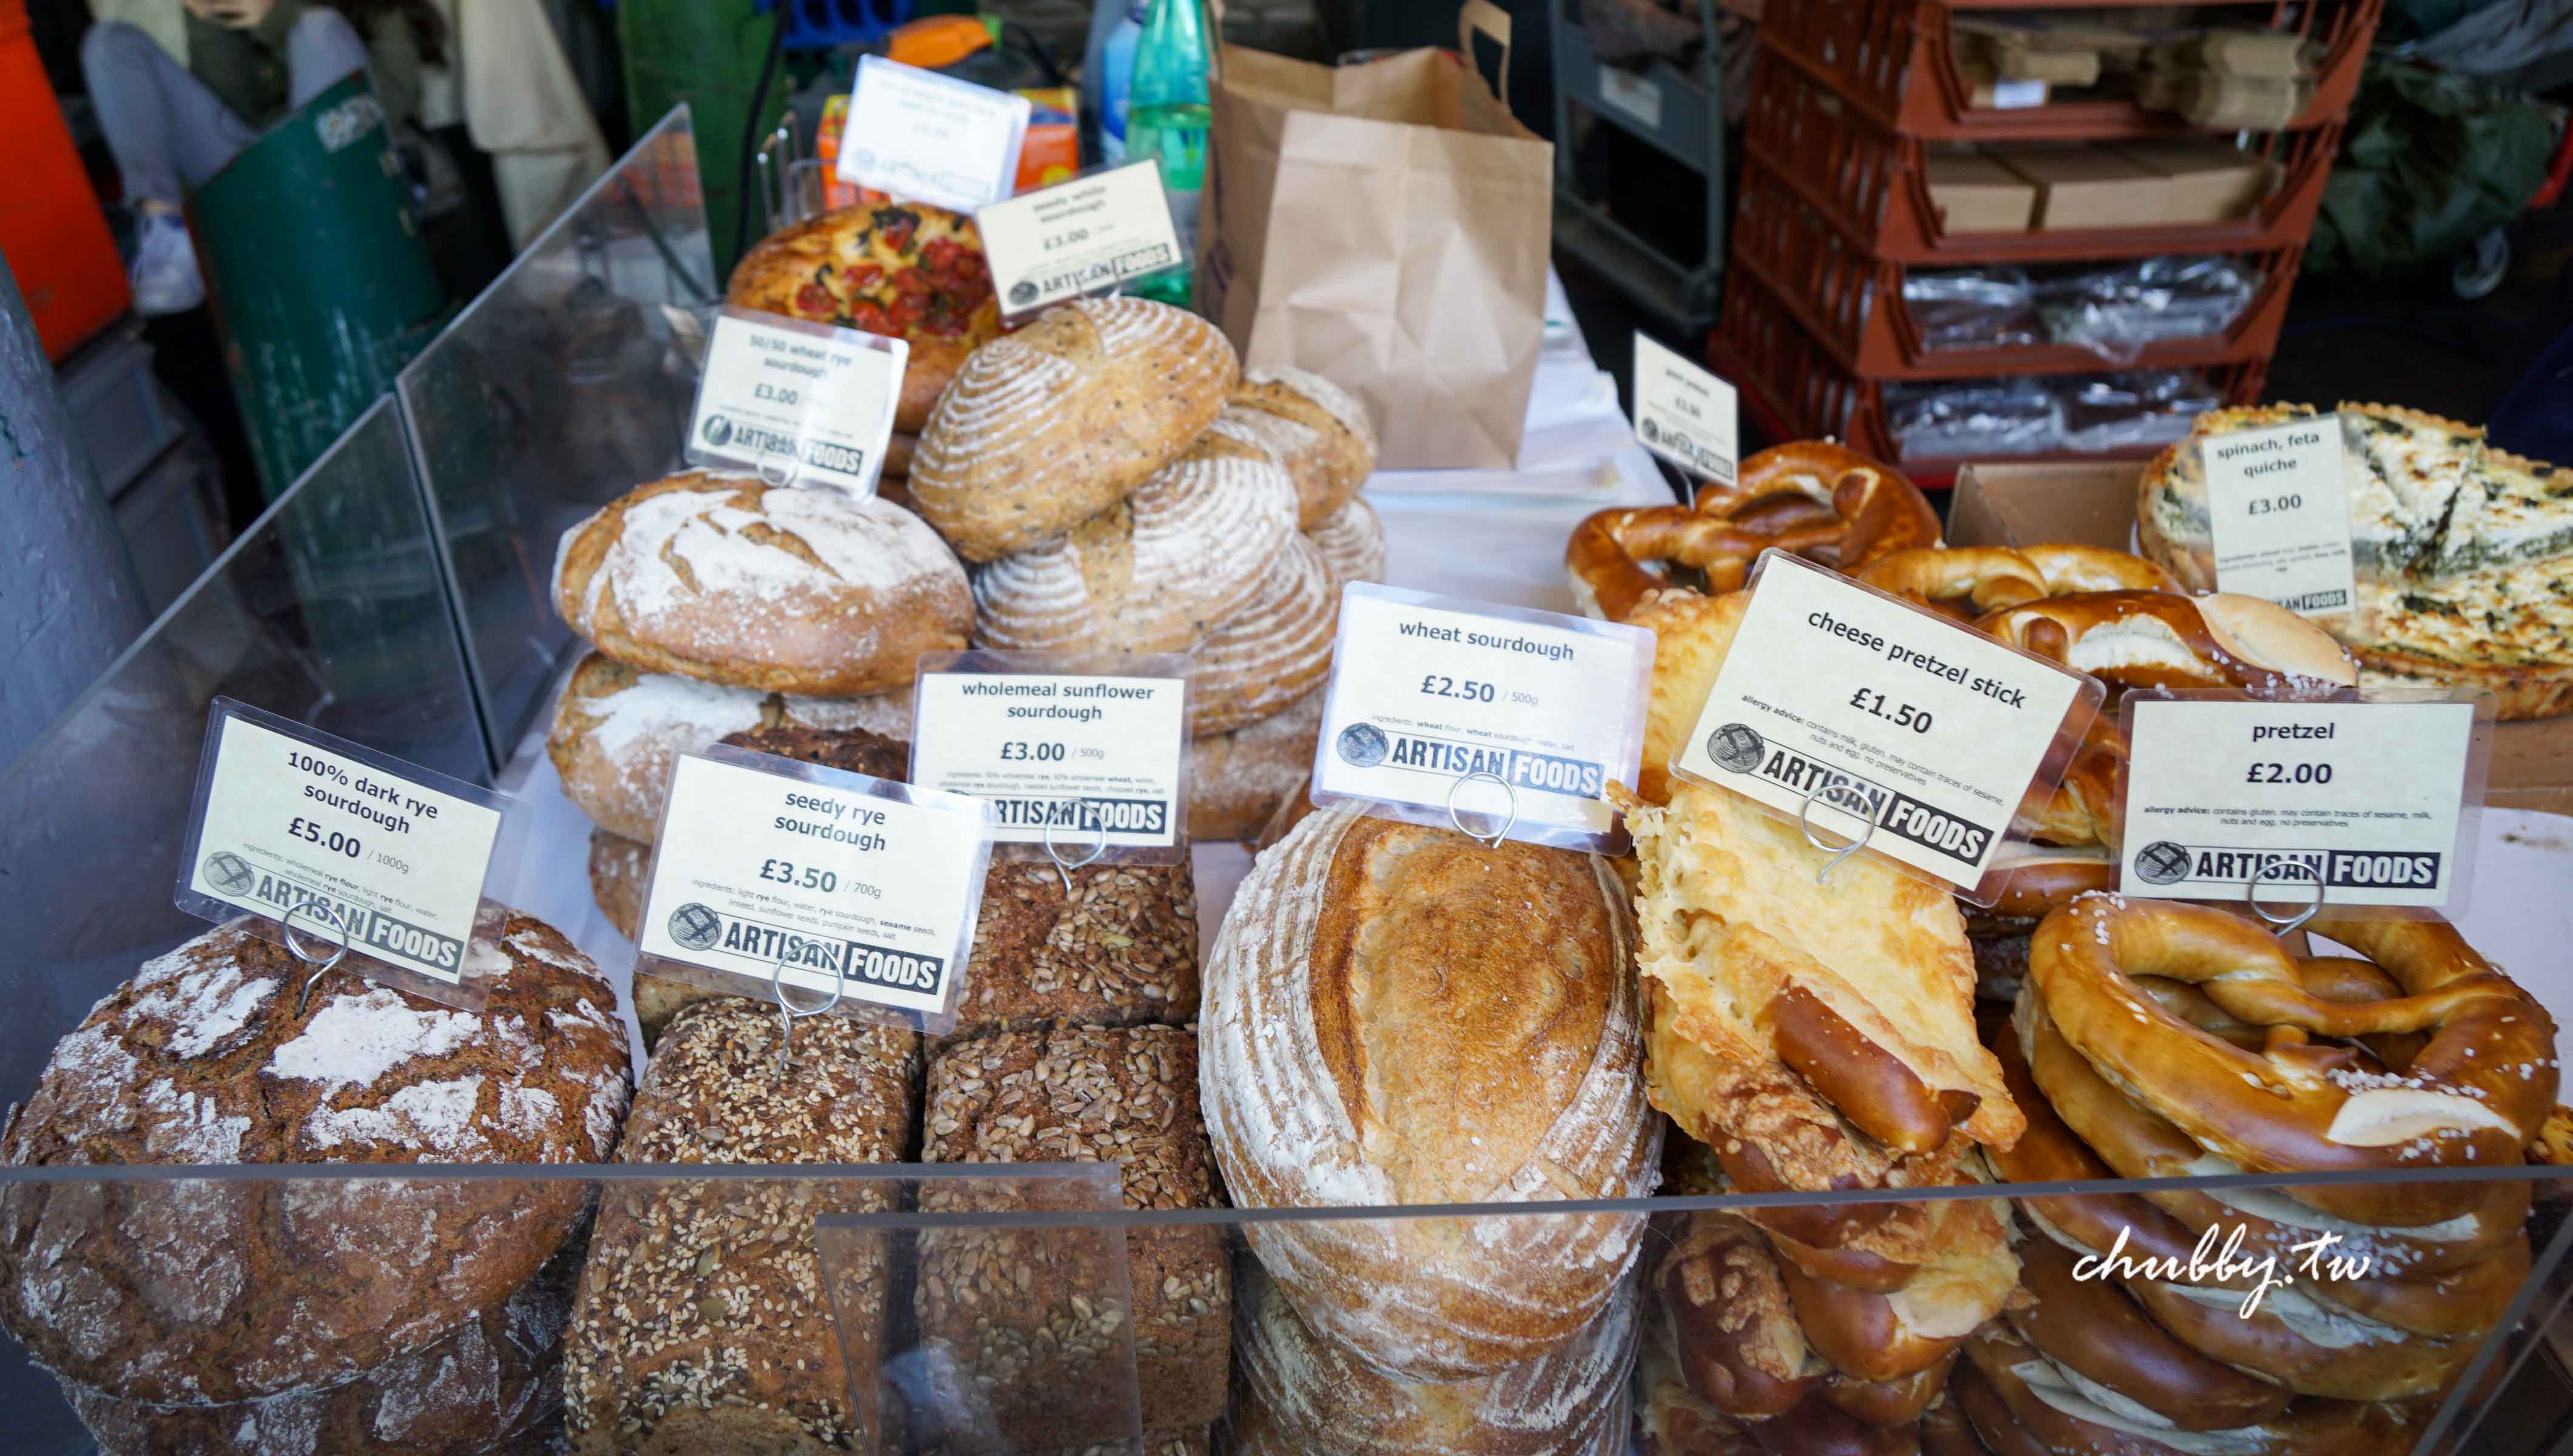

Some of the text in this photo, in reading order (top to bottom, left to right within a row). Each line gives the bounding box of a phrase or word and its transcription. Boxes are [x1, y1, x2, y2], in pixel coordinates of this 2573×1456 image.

[754, 383, 797, 405] £3.00
[2217, 433, 2320, 460] spinach, feta
[2244, 459, 2297, 478] quiche
[2248, 494, 2302, 515] £3.00
[1399, 622, 1575, 660] wheat sourdough
[1808, 609, 2026, 709] cheese pretzel stick
[962, 682, 1155, 699] wholemeal sunflower
[1421, 675, 1495, 703] £2.50
[1512, 692, 1538, 706] 500g
[1007, 704, 1103, 722] sourdough
[1850, 686, 1933, 734] £1.50
[1417, 719, 1443, 730] wheat
[1466, 728, 1493, 738] wheat
[1742, 694, 1772, 713] allergy
[1774, 707, 1804, 724] advice:
[1805, 721, 1838, 738] contains
[1889, 753, 1905, 766] may
[1907, 759, 1936, 776] contain
[1938, 771, 1961, 786] traces
[1963, 781, 1972, 790] of
[2252, 723, 2335, 743] pretzel
[1000, 741, 1066, 761] £3.00
[1080, 748, 1104, 759] 500g
[1391, 737, 1600, 793] ARTISAN FOODS
[1809, 733, 1827, 746] nuts
[1828, 740, 1844, 753] and
[1864, 756, 1875, 765] no
[1875, 759, 1927, 786] preservatives
[288, 751, 439, 819] 100% dark rye
[2247, 763, 2333, 784] £2.00
[303, 783, 411, 834] sourdough
[785, 790, 885, 826] seedy rye
[995, 800, 1162, 831] RTISAN FOODS
[1763, 750, 1985, 858] ARTISAN FOODS
[2144, 805, 2175, 815] allergy
[2177, 805, 2210, 814] advice:
[2213, 807, 2247, 816] contains
[2281, 809, 2298, 818] may
[2301, 809, 2331, 818] contain
[2335, 810, 2360, 818] traces
[2362, 810, 2372, 818] of
[774, 814, 885, 851] sourdough
[2220, 817, 2239, 826] nuts
[2241, 817, 2257, 826] and
[287, 817, 361, 858] £5.00
[377, 853, 410, 874] 1000g
[759, 858, 837, 894] £3.50
[854, 882, 882, 900] 700g
[2196, 852, 2434, 885] ARTISAN FOODS
[323, 883, 337, 894] rye
[325, 874, 338, 884] rye
[380, 894, 393, 905] rye
[256, 874, 458, 968] ARTISAN FOODS
[738, 888, 754, 900] light
[756, 893, 770, 903] rye
[819, 908, 833, 917] rye
[879, 919, 911, 932] sesame
[759, 904, 794, 920] sunflower
[822, 920, 855, 933] pumpkin
[882, 930, 896, 940] salt
[723, 921, 938, 989] ARTISAN FOODS
